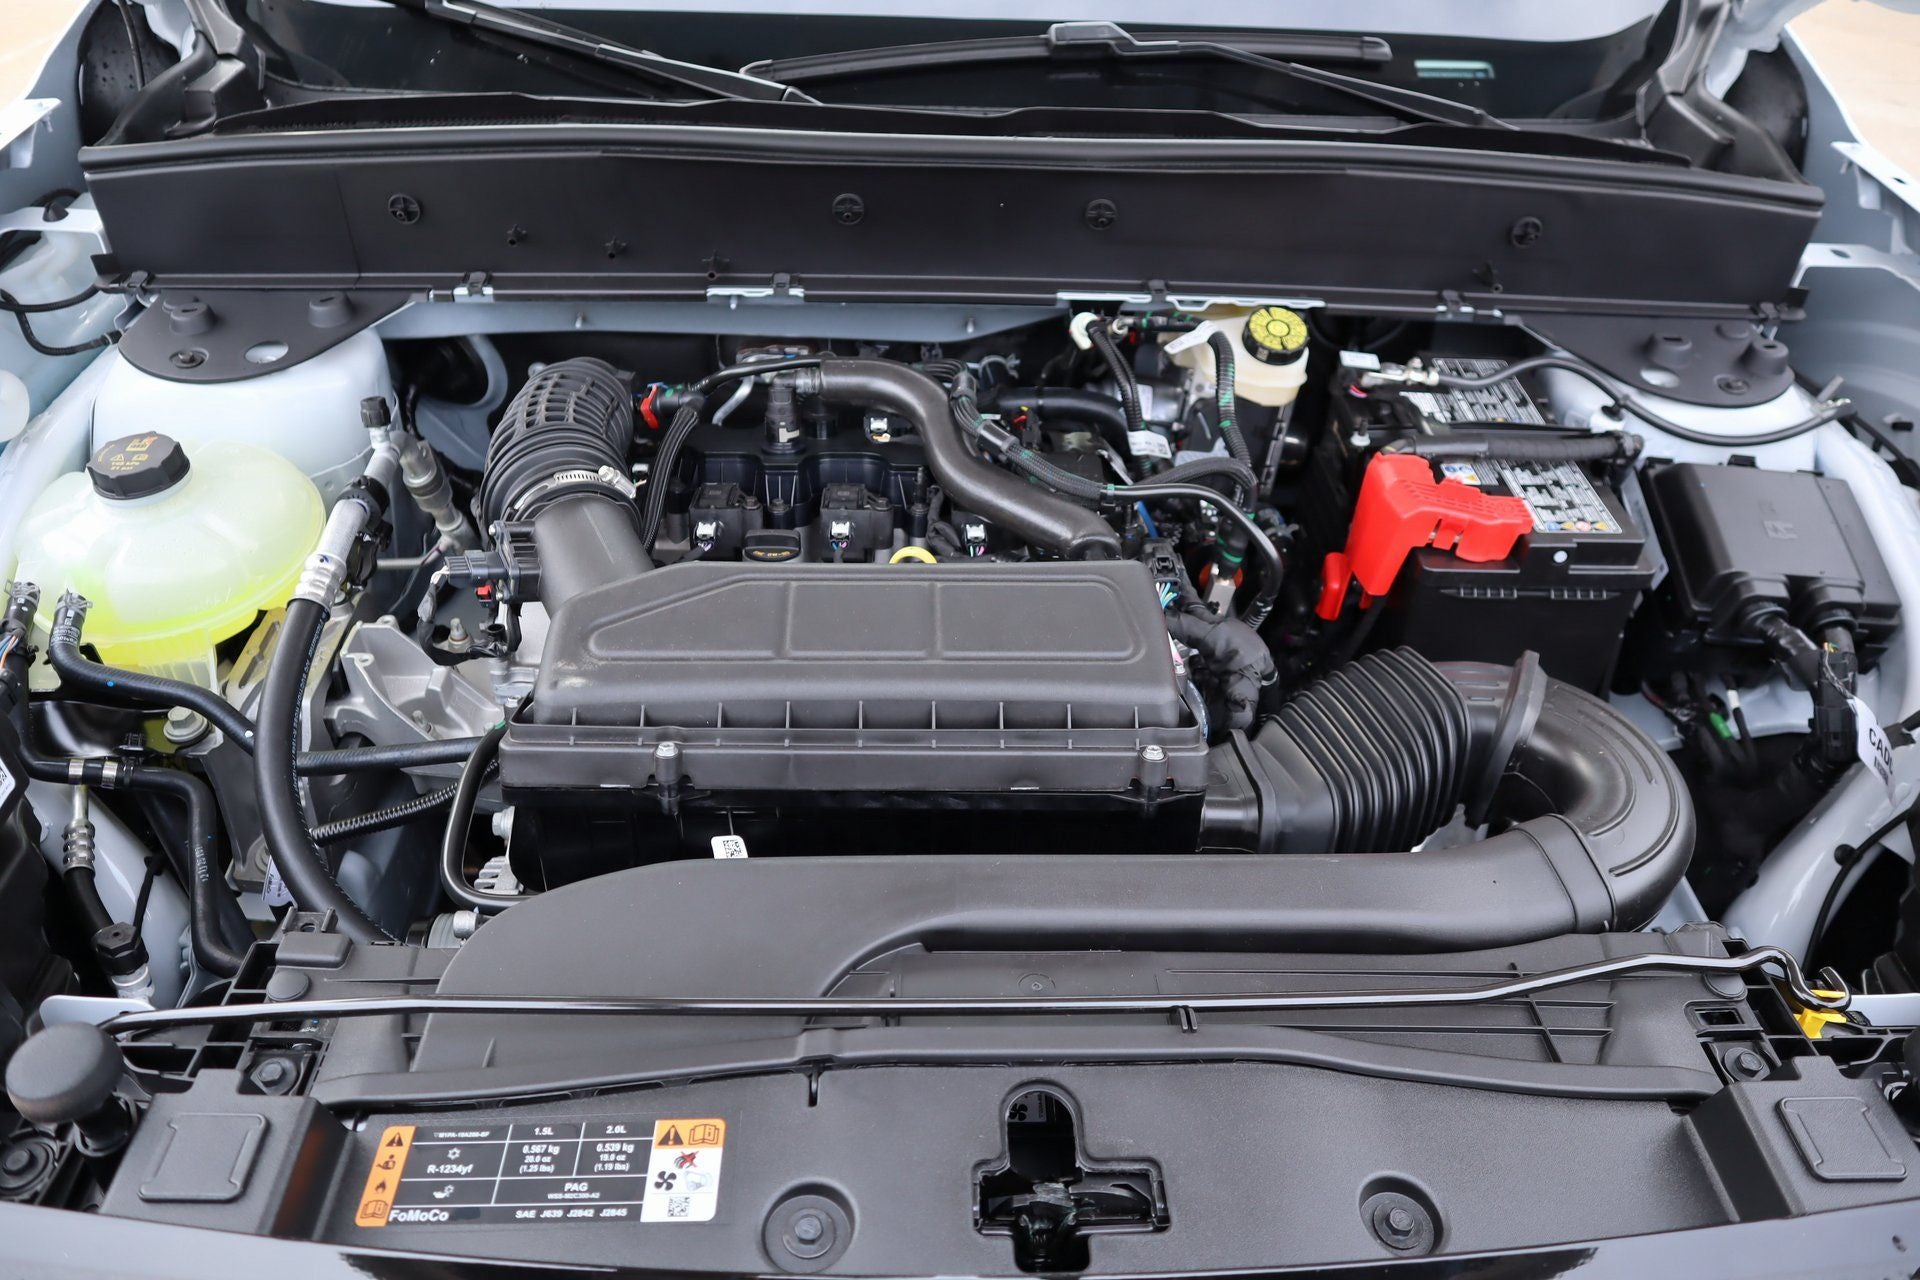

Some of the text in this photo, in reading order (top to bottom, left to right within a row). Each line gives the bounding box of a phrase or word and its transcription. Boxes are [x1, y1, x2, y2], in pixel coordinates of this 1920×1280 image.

[534, 1126, 554, 1135] 1.5L
[606, 1125, 626, 1134] 2.0L
[548, 1144, 560, 1155] kg
[622, 1143, 634, 1153] kg
[426, 1164, 474, 1176] R-1234yf
[564, 1182, 589, 1192] PAG
[388, 1208, 450, 1222] FoMoCo
[515, 1209, 536, 1219] SAE
